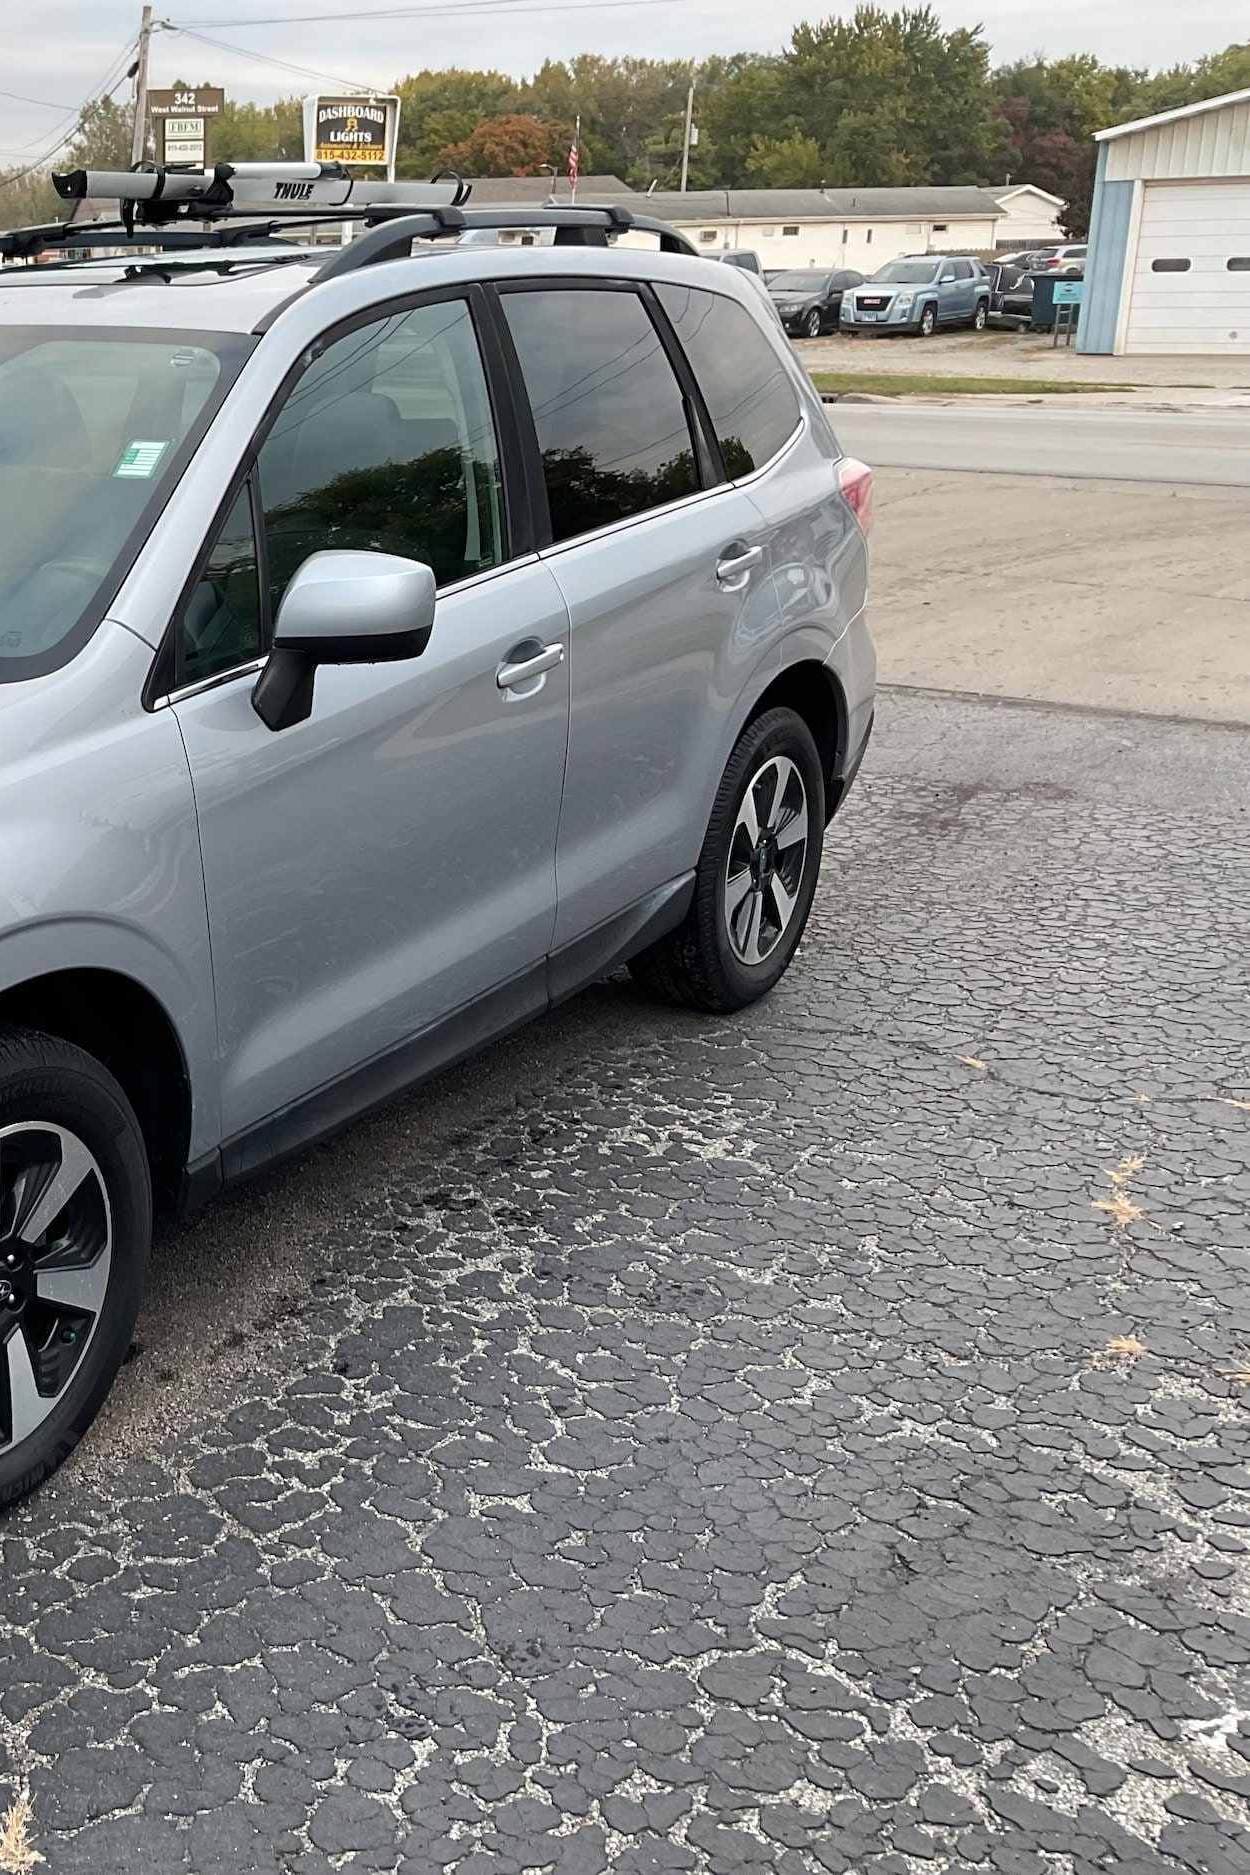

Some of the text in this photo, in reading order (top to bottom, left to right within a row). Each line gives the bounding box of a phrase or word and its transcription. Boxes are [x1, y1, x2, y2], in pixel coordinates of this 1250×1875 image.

[174, 93, 195, 104] 342
[151, 105, 218, 113] West Walnut Street
[319, 105, 384, 123] DASHBOARD
[330, 131, 372, 142] LIGHTS
[316, 150, 384, 160] 815-432-5112
[274, 182, 314, 200] THULE
